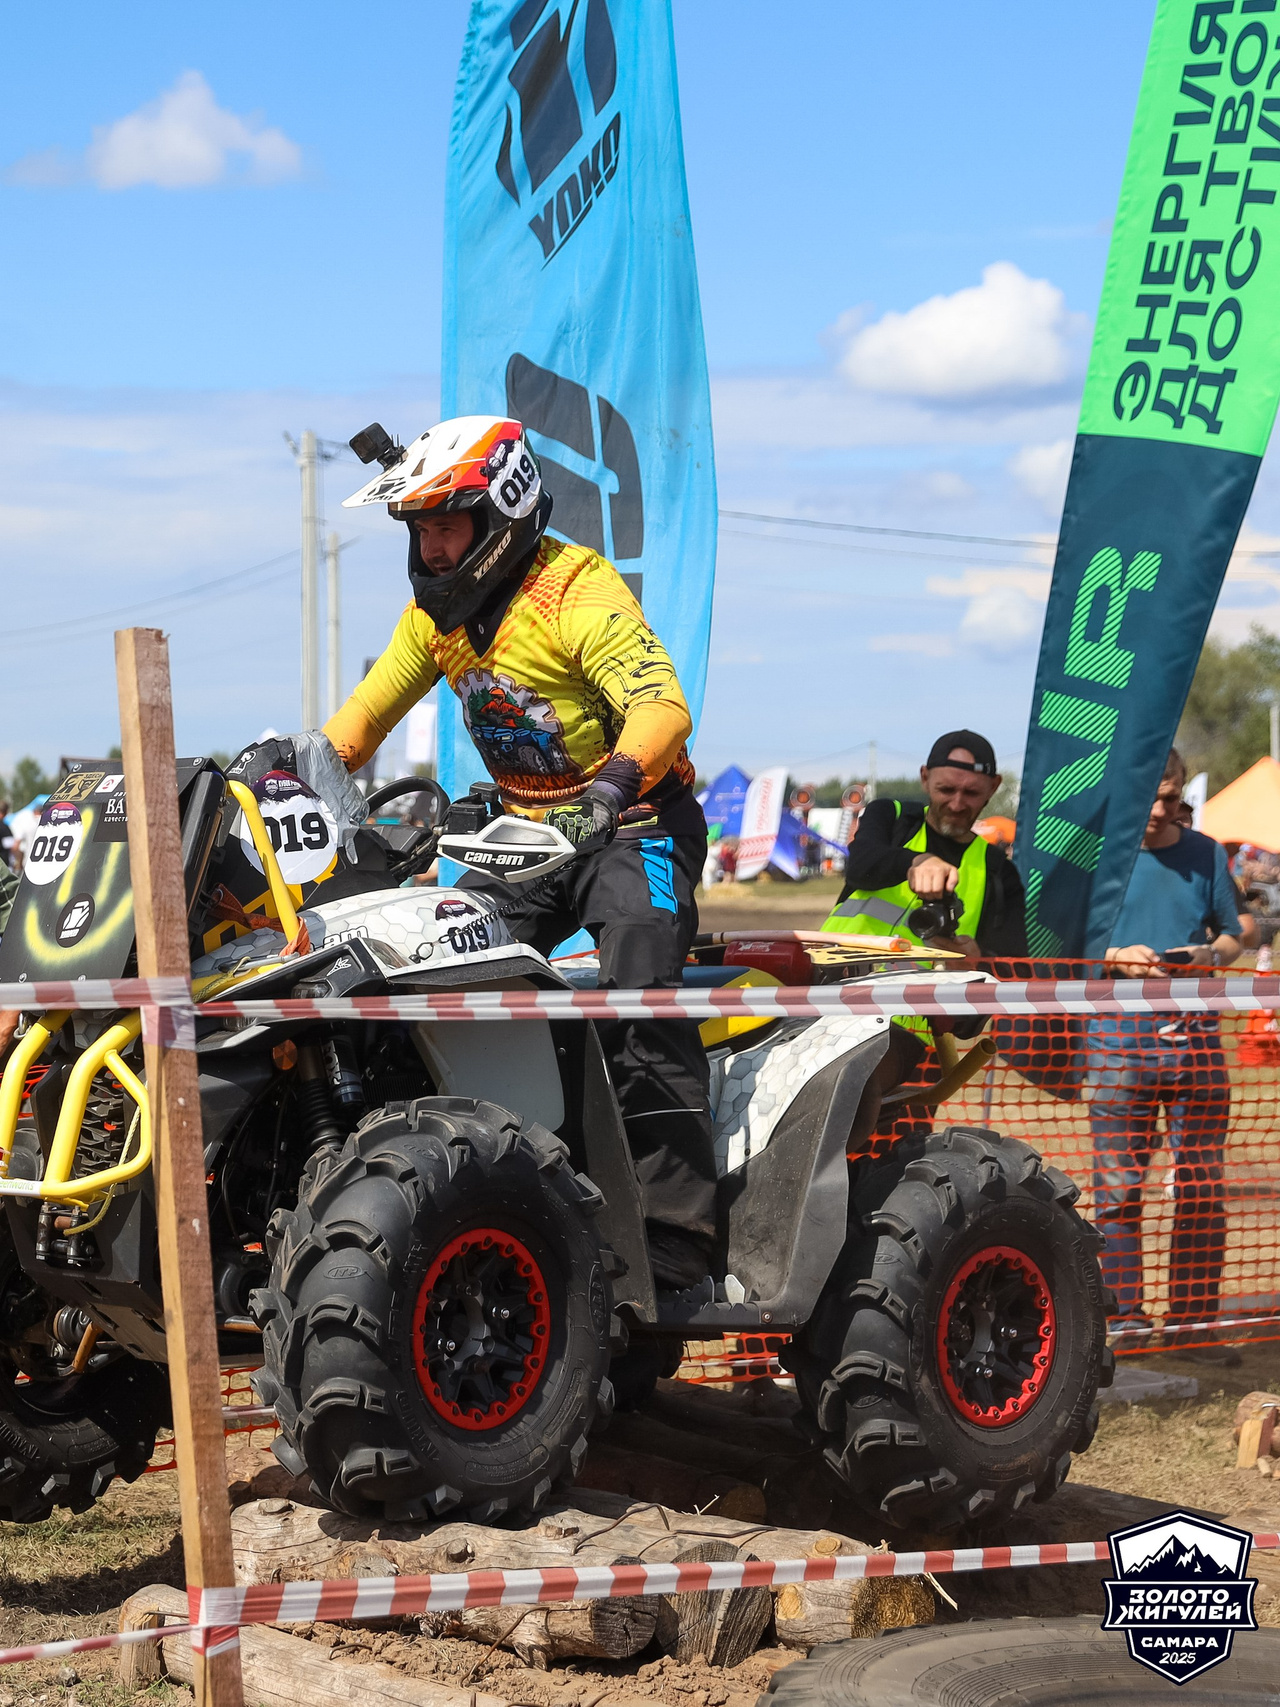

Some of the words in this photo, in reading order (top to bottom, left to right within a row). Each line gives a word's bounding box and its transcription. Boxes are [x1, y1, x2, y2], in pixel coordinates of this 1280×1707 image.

[528, 112, 621, 262] YOKO
[1113, 1, 1234, 421] ЭНЕРГИЯ
[1152, 240, 1223, 429] ДЛЯ
[500, 454, 535, 508] 019
[30, 835, 74, 862] 019
[464, 851, 525, 866] can-am
[447, 922, 490, 953] 019
